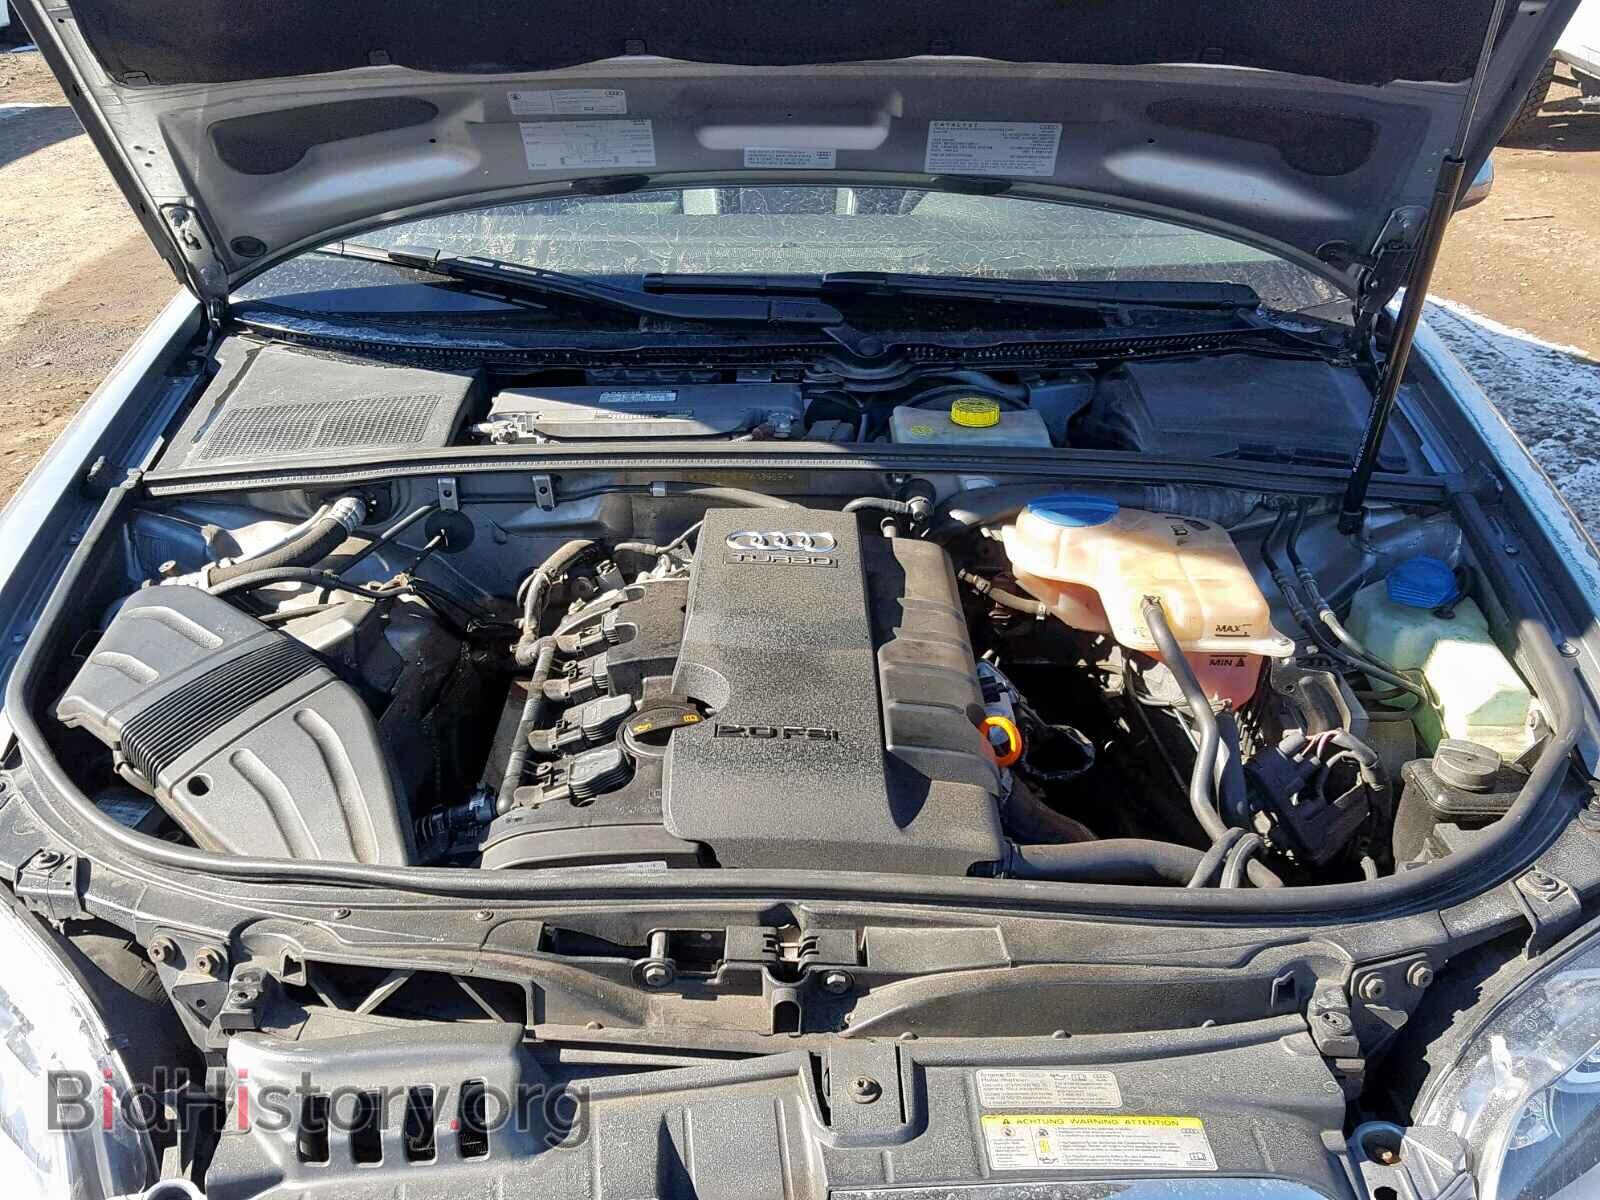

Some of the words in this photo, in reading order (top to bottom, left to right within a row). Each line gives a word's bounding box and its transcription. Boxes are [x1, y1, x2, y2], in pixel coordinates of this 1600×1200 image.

[732, 553, 833, 566] TURBO
[1215, 624, 1241, 633] MAX
[1209, 658, 1233, 667] MIN
[714, 723, 778, 740] 2.0
[782, 725, 839, 742] FSI
[1016, 1118, 1065, 1126] ACHTUNG
[1070, 1118, 1120, 1126] WARNING
[1124, 1119, 1180, 1127] ATTENTION
